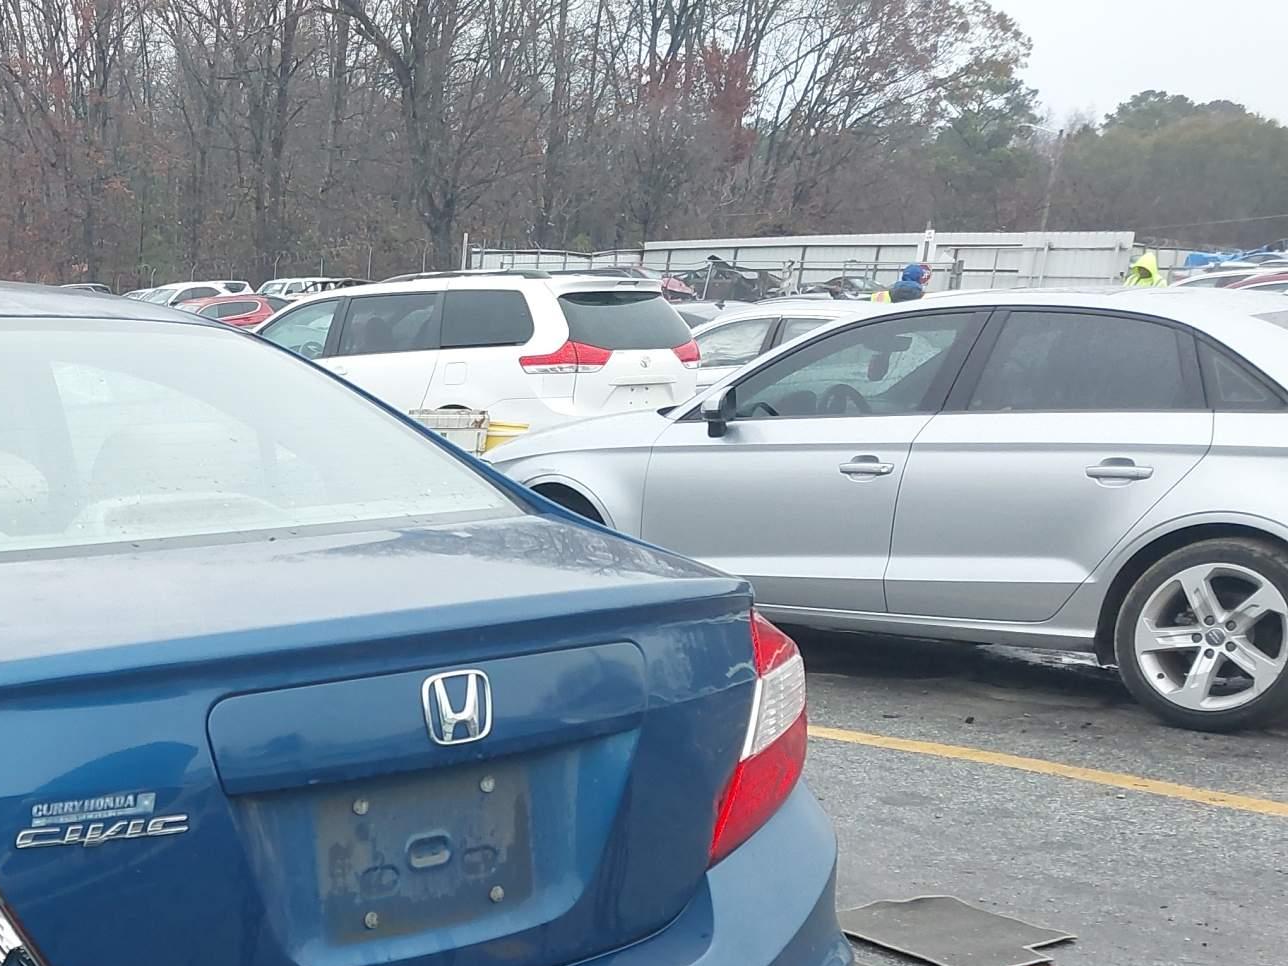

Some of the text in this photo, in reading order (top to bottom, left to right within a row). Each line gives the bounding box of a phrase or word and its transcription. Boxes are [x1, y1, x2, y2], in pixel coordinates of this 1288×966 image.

[32, 800, 83, 818] CURRY
[83, 794, 135, 812] HONDA
[16, 814, 189, 849] CIVIC
